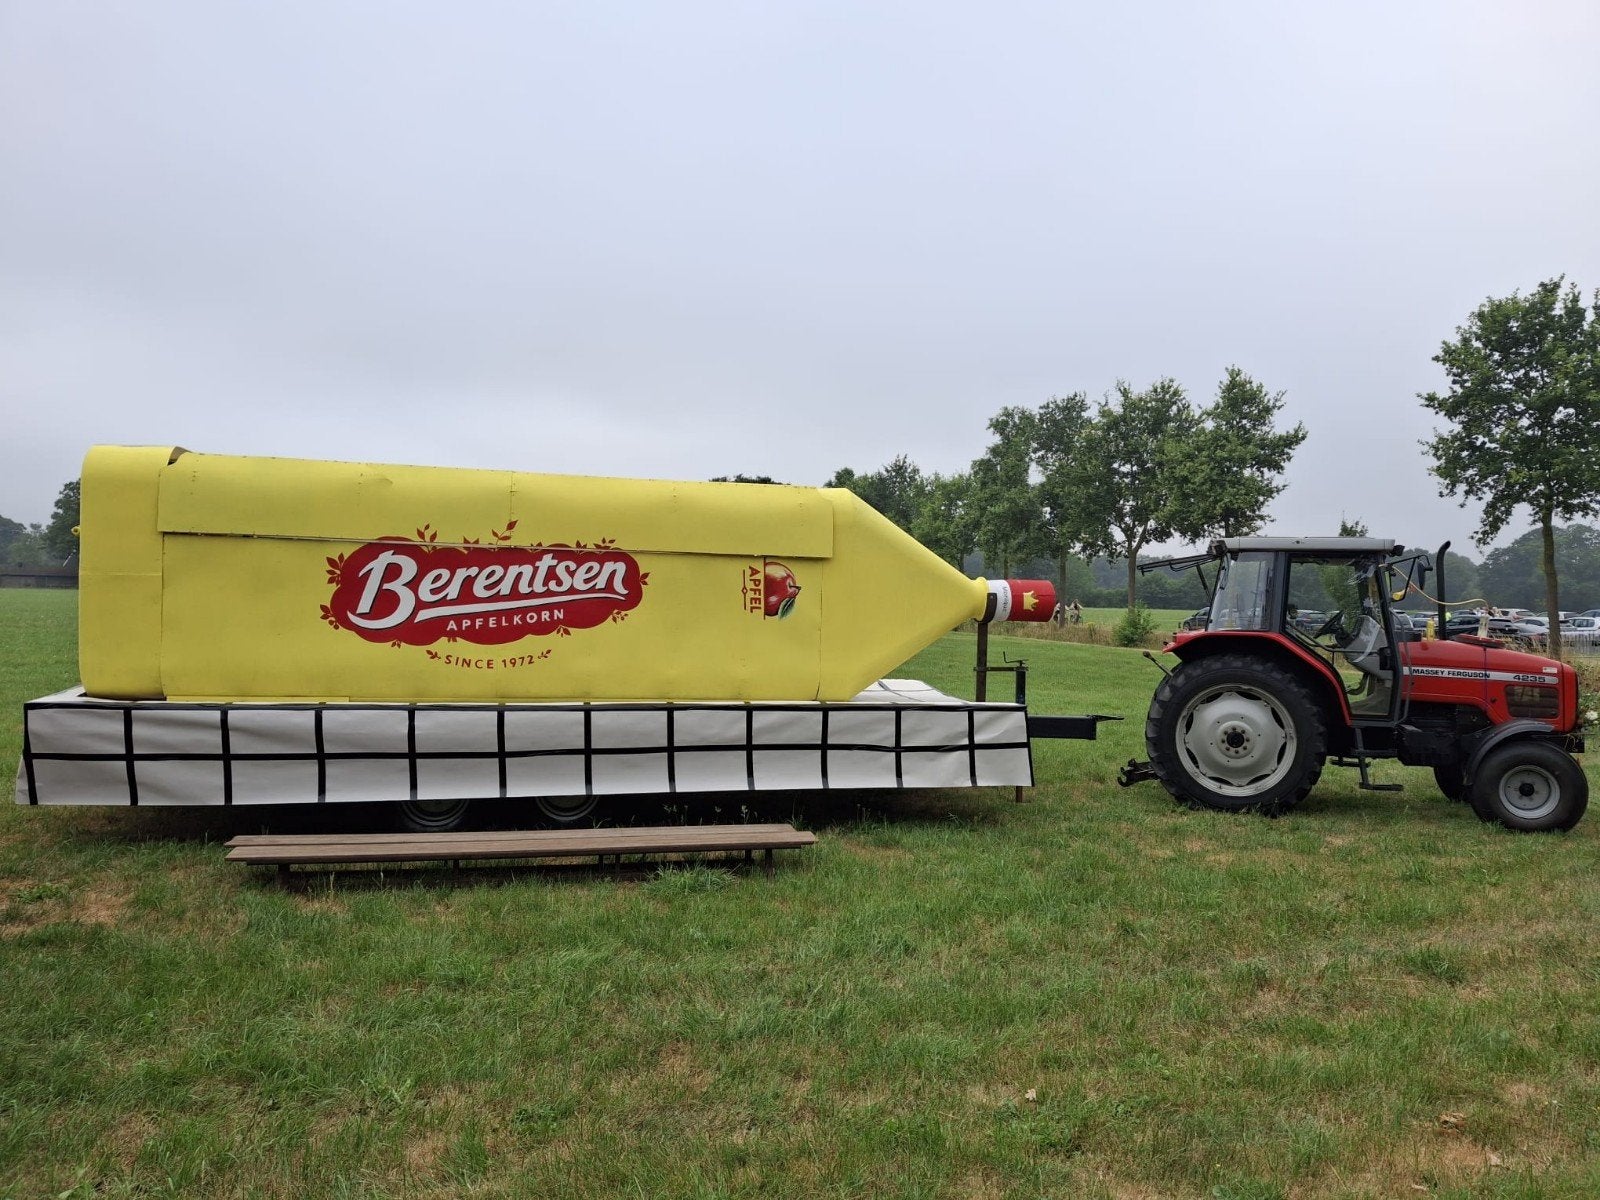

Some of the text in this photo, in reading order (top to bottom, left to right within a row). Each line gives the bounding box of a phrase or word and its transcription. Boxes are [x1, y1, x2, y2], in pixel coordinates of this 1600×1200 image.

[347, 550, 629, 629] Berentsen
[748, 565, 762, 613] APFEL
[446, 609, 564, 631] APFELKORN
[444, 654, 534, 669] SINCE 1972
[1412, 667, 1546, 683] MASSEY FERGUSON 4235
